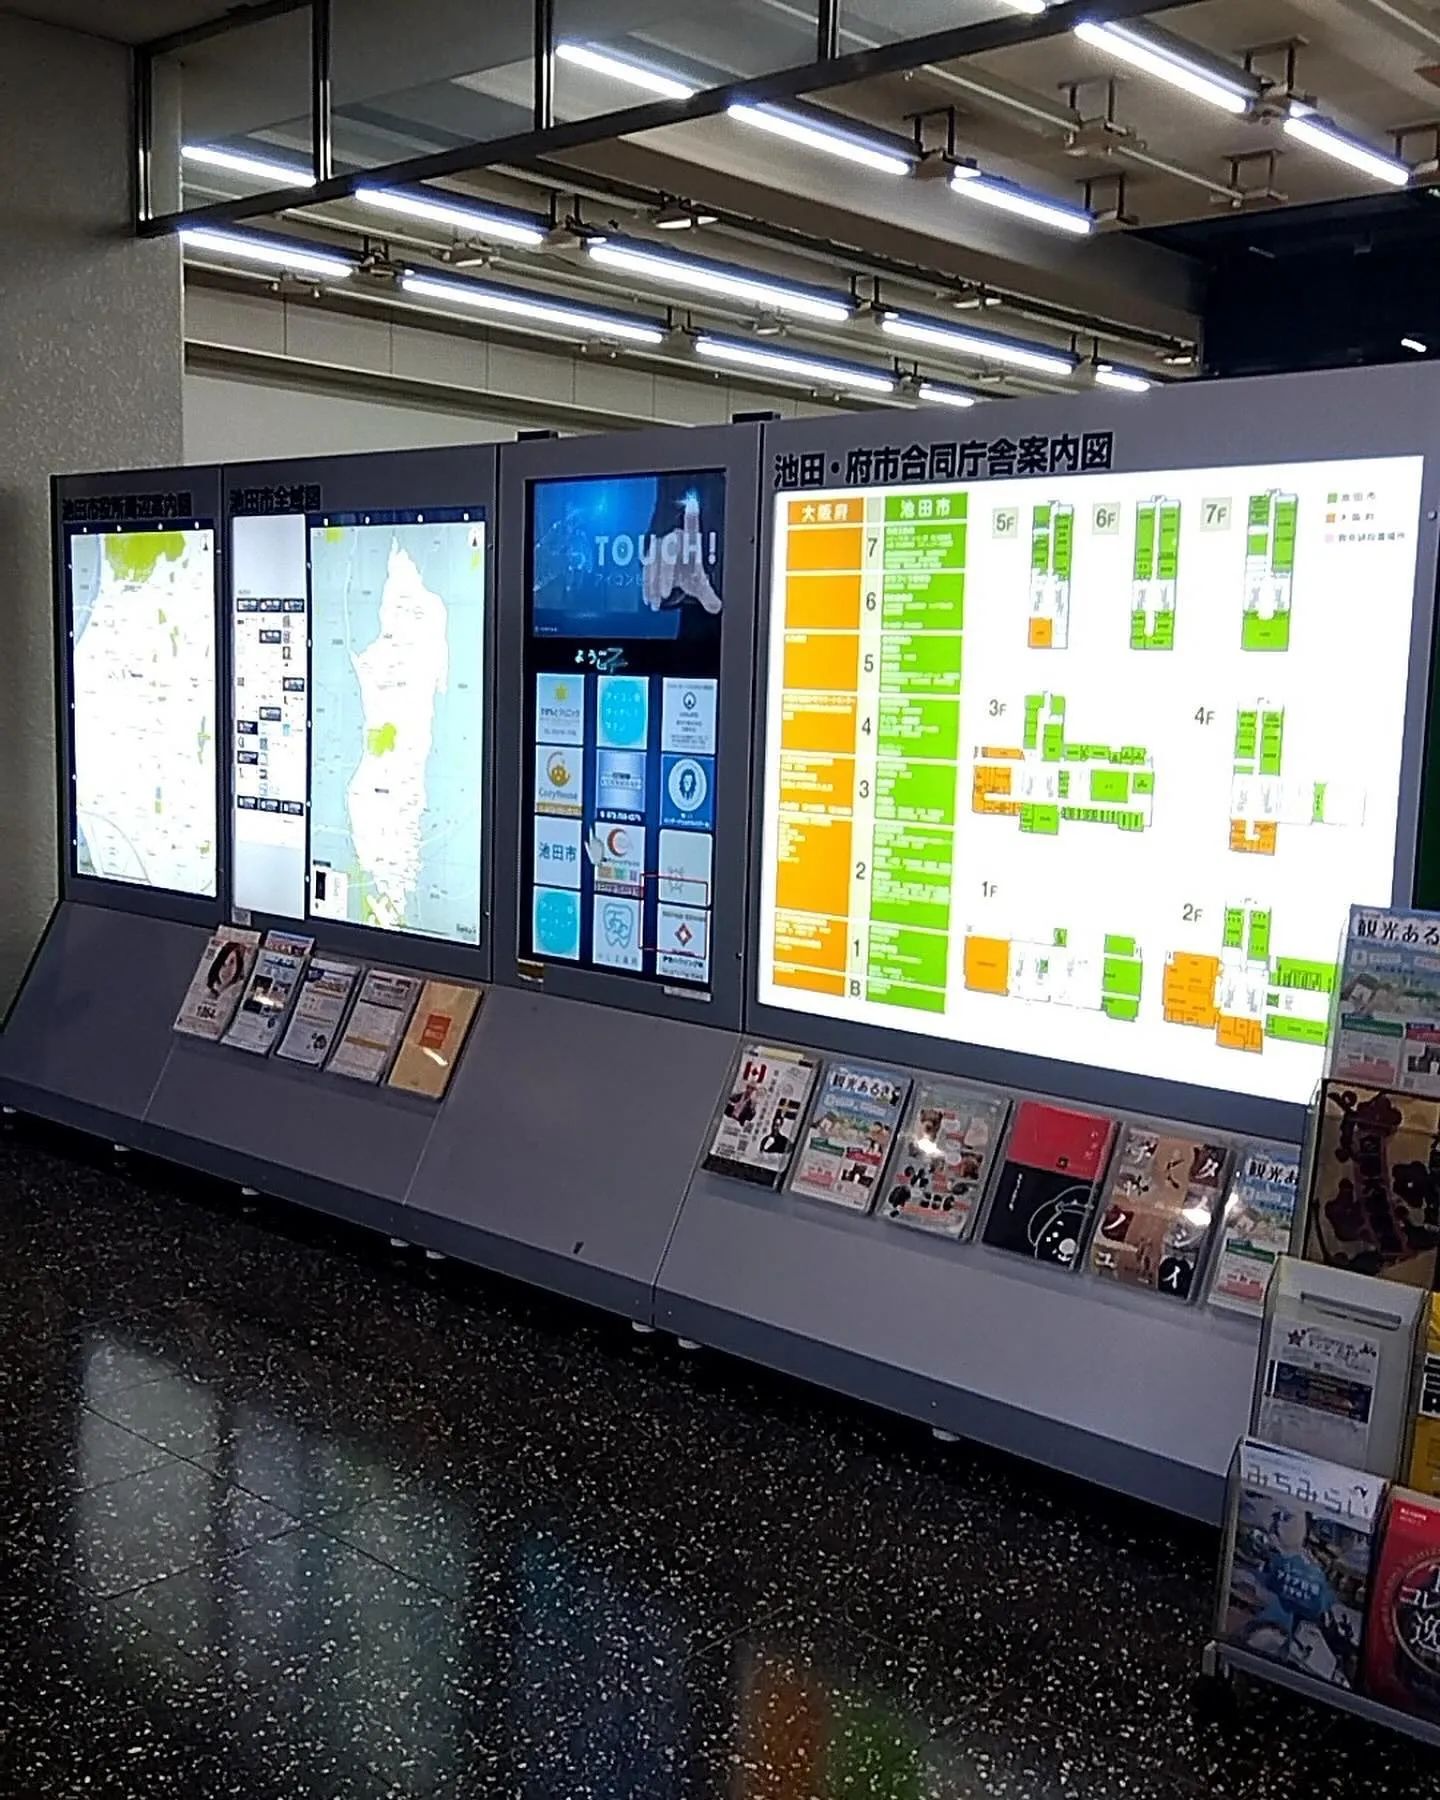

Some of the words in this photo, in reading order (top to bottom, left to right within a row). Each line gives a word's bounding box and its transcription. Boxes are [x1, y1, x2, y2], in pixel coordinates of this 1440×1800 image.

[900, 498, 951, 519] 池田市
[1095, 507, 1116, 529] 6F
[1205, 503, 1227, 526] 7F
[996, 510, 1015, 533] 5F
[595, 532, 717, 566] TOUCH!
[867, 537, 878, 558] 7
[866, 592, 877, 612] 6
[864, 654, 874, 673] 5
[988, 698, 1007, 717] 3F
[1194, 706, 1215, 726] 4F
[861, 717, 872, 737] 4
[859, 780, 870, 799] 3
[538, 841, 577, 863] 池田市
[856, 862, 866, 880] 2
[981, 881, 998, 898] 1F
[1182, 903, 1203, 922] 2F
[854, 939, 861, 957] 1
[850, 980, 861, 996] B
